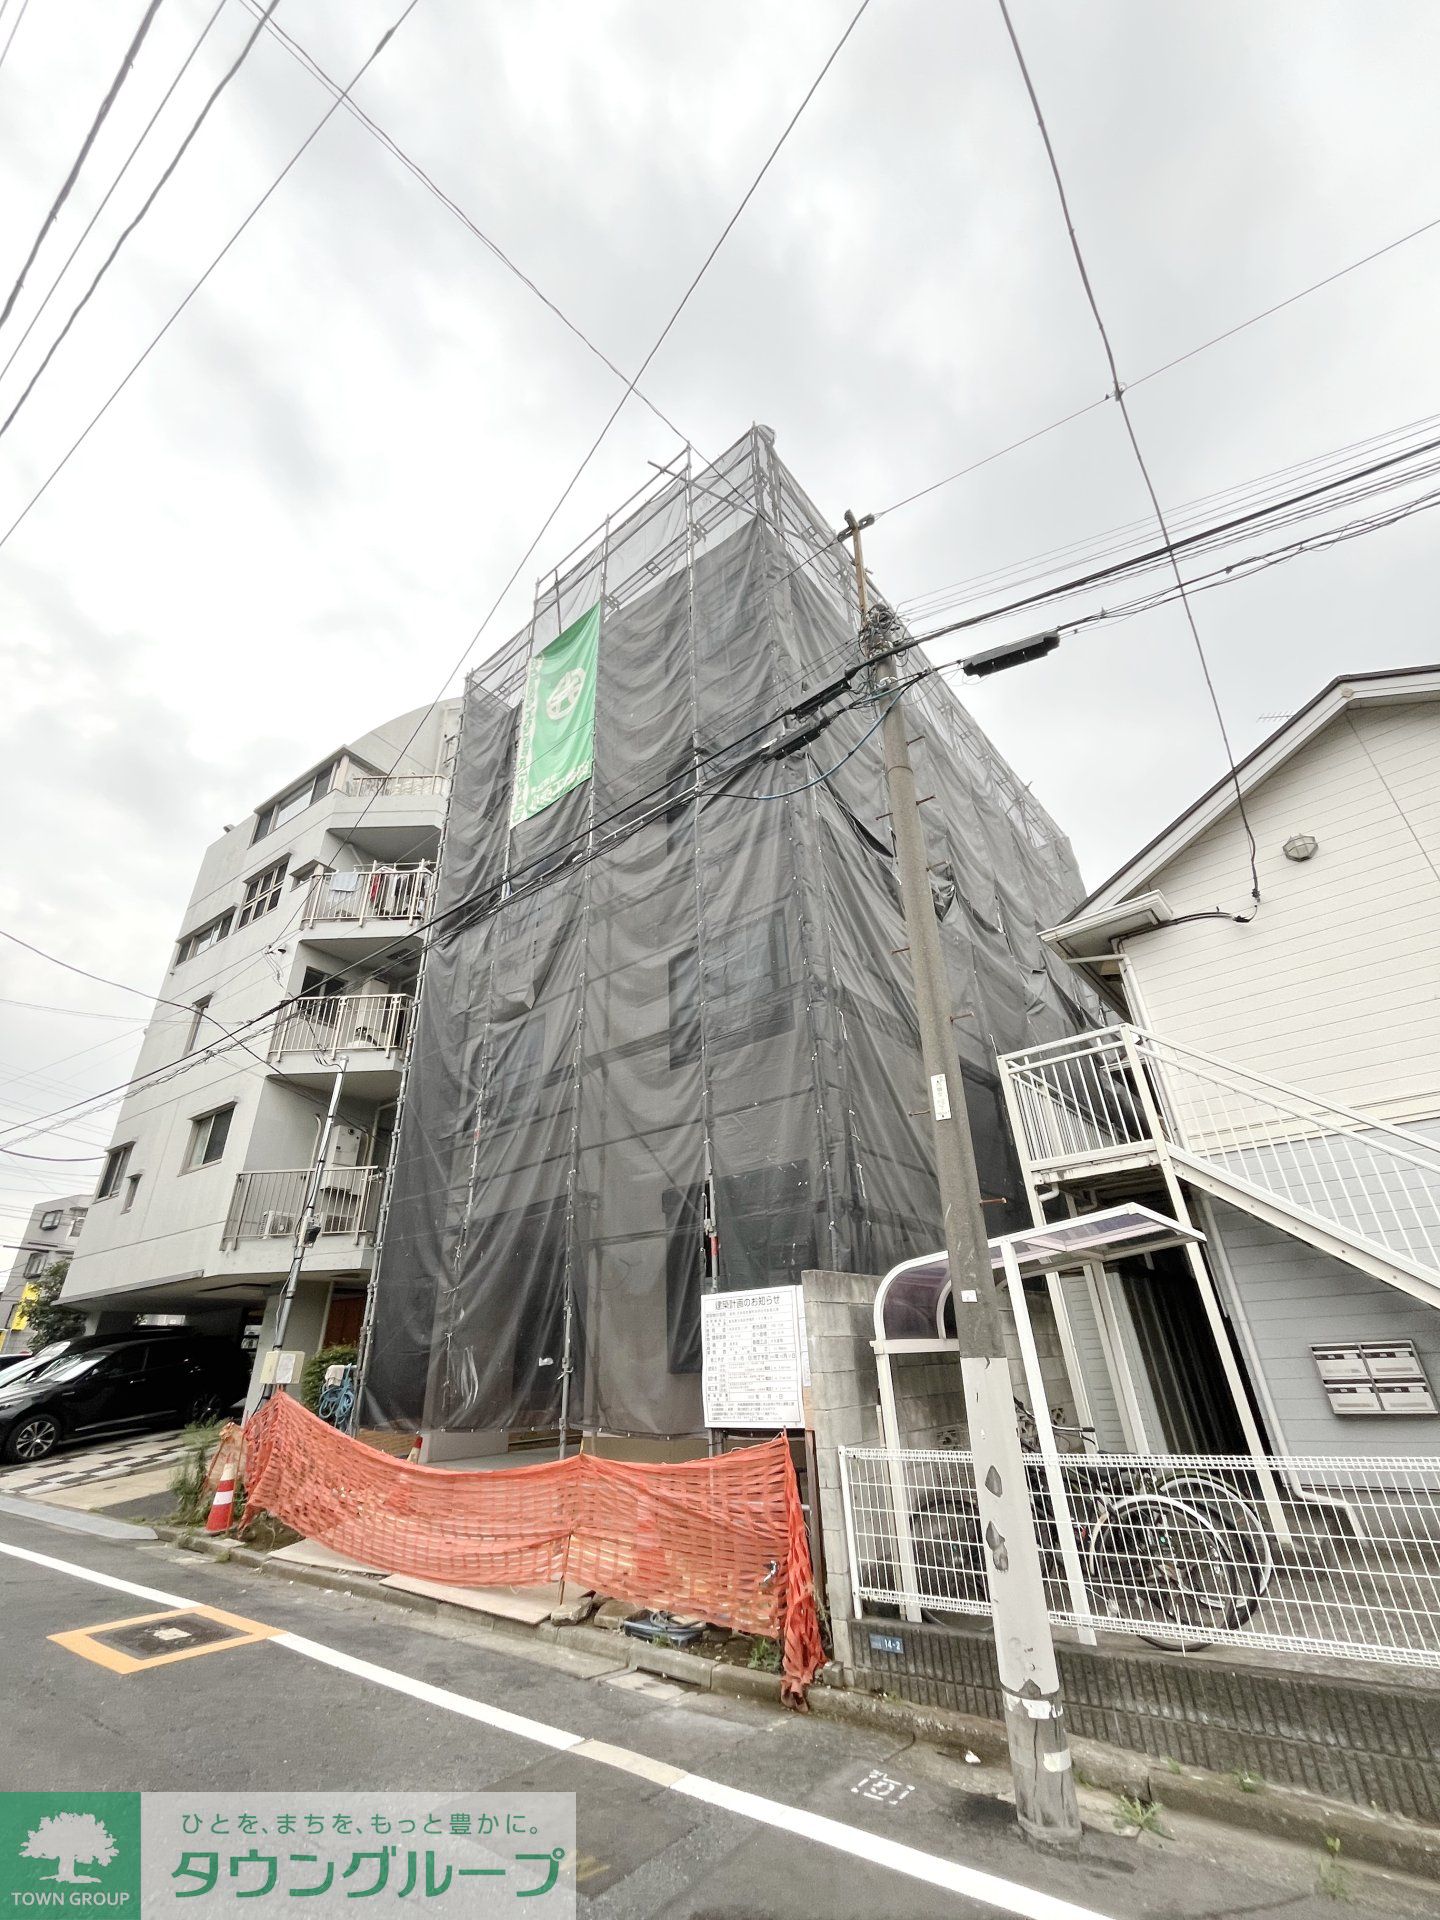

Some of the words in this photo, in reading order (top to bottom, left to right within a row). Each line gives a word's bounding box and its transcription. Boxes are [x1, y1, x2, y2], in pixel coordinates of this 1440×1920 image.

[715, 1296, 780, 1310] 建築計画のお知らせ
